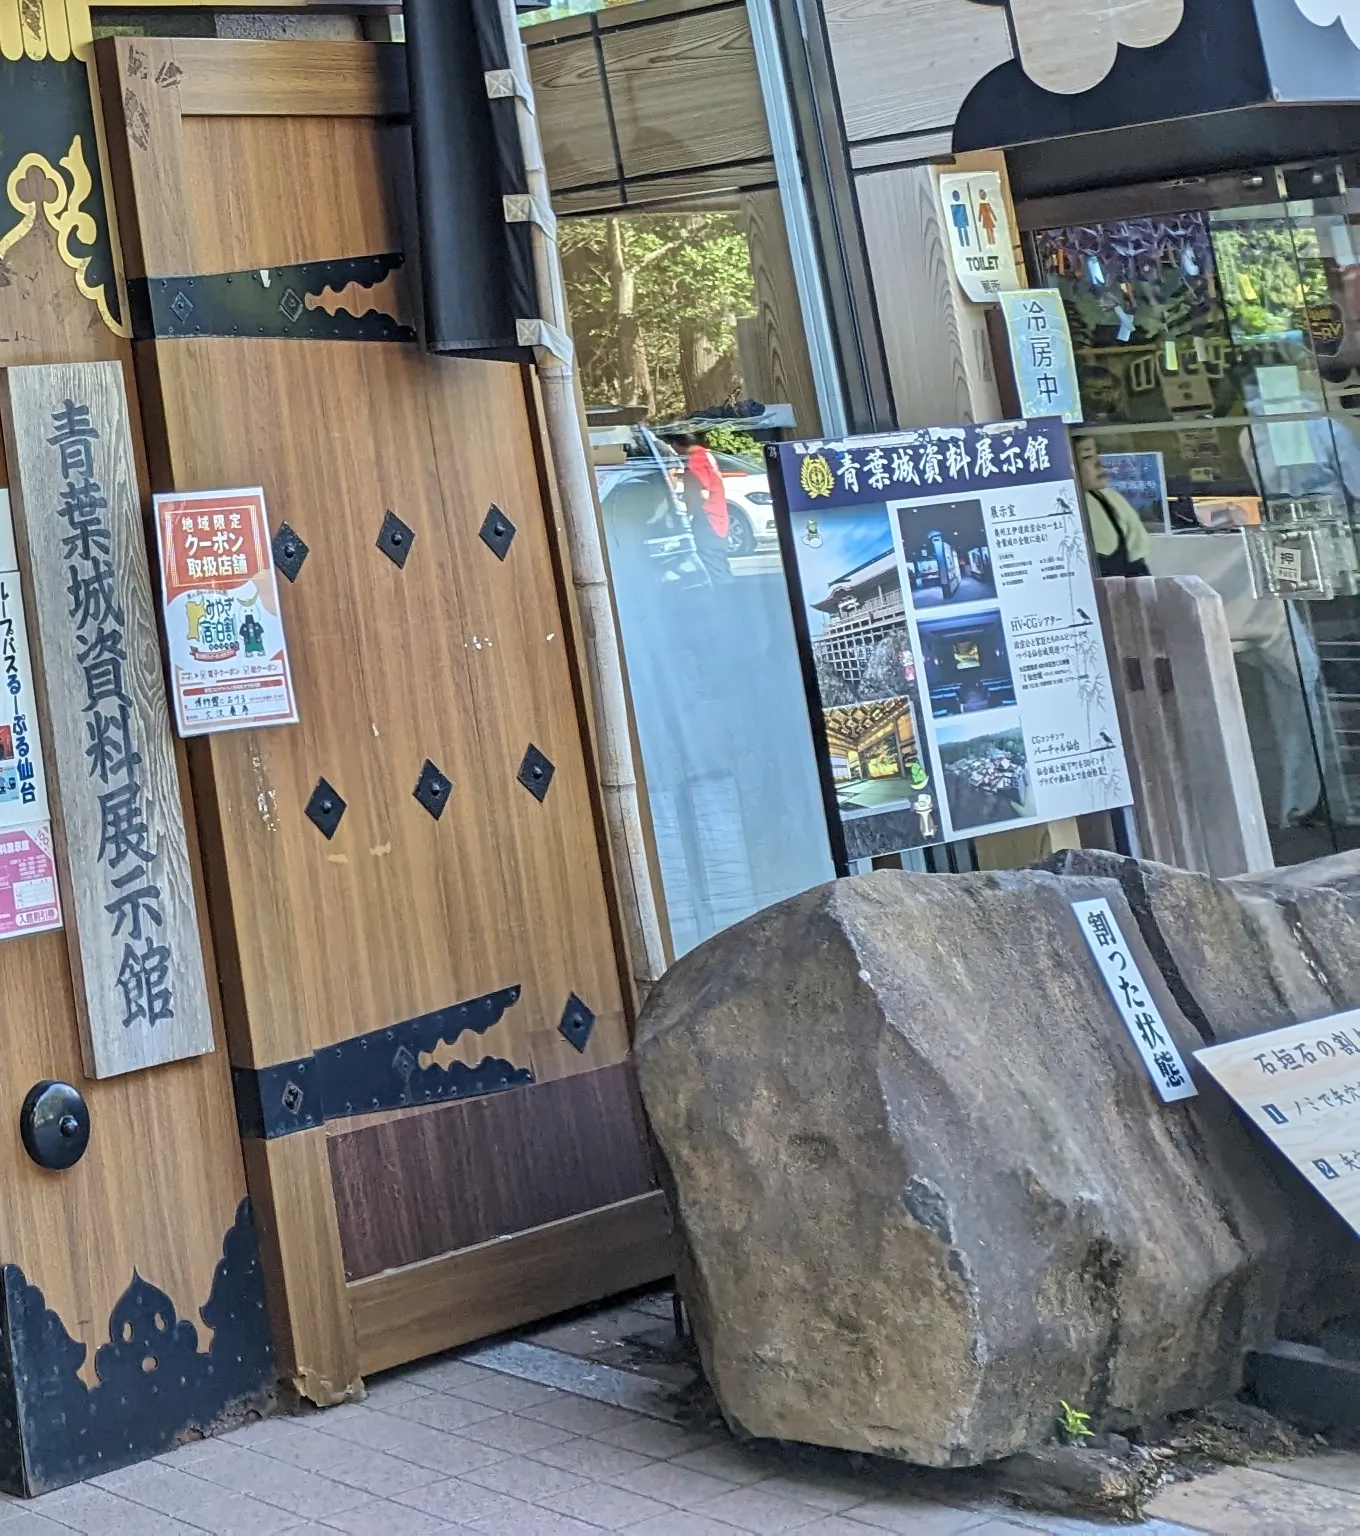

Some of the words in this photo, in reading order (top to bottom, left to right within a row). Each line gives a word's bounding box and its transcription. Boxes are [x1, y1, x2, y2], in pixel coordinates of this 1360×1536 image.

[966, 255, 999, 272] TOILET
[1022, 300, 1058, 404] 冷房中
[836, 436, 1051, 493] 青葉城資料展示館
[182, 513, 242, 533] 地域限定
[990, 504, 1016, 519] 展示室
[184, 533, 244, 557] クーポン
[186, 554, 248, 579] 取扱店舗
[46, 398, 175, 1028] 青葉城資料展示館
[1087, 910, 1185, 1088] 割った状態
